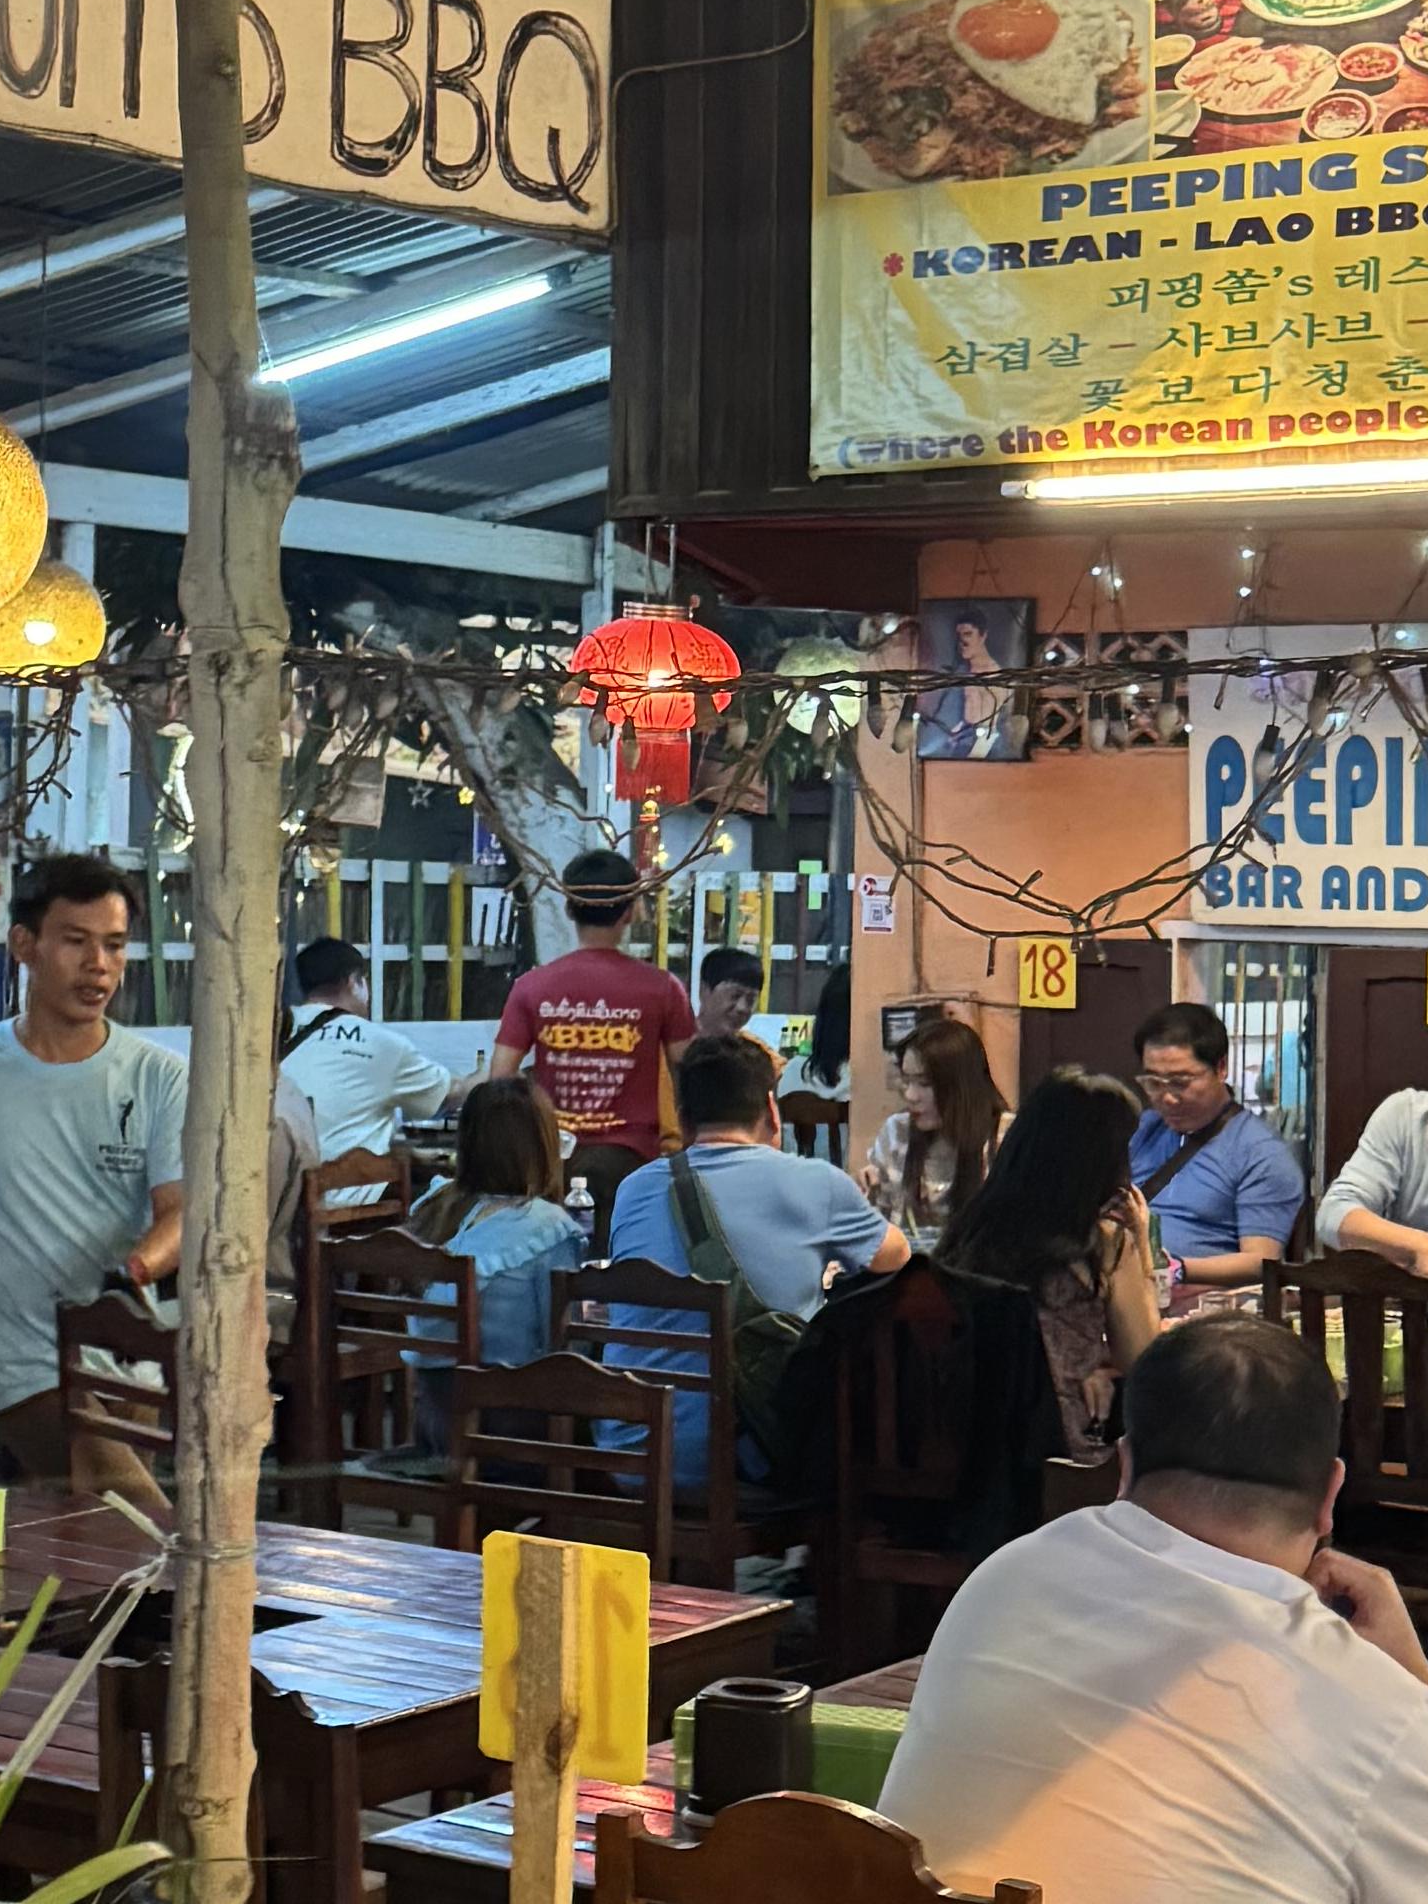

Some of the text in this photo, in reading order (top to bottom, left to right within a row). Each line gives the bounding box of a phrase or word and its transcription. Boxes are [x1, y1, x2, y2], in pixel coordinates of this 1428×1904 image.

[1041, 151, 1359, 222] PEEPING
[912, 229, 1143, 279] KOREAN
[1194, 213, 1315, 252] LAO
[934, 332, 1091, 377] 삼겹살
[1152, 310, 1384, 358] 샤브샤브
[997, 424, 1070, 455] the
[1082, 414, 1254, 450] Korean
[1204, 863, 1304, 910] BAR
[1024, 943, 1068, 1000] 18
